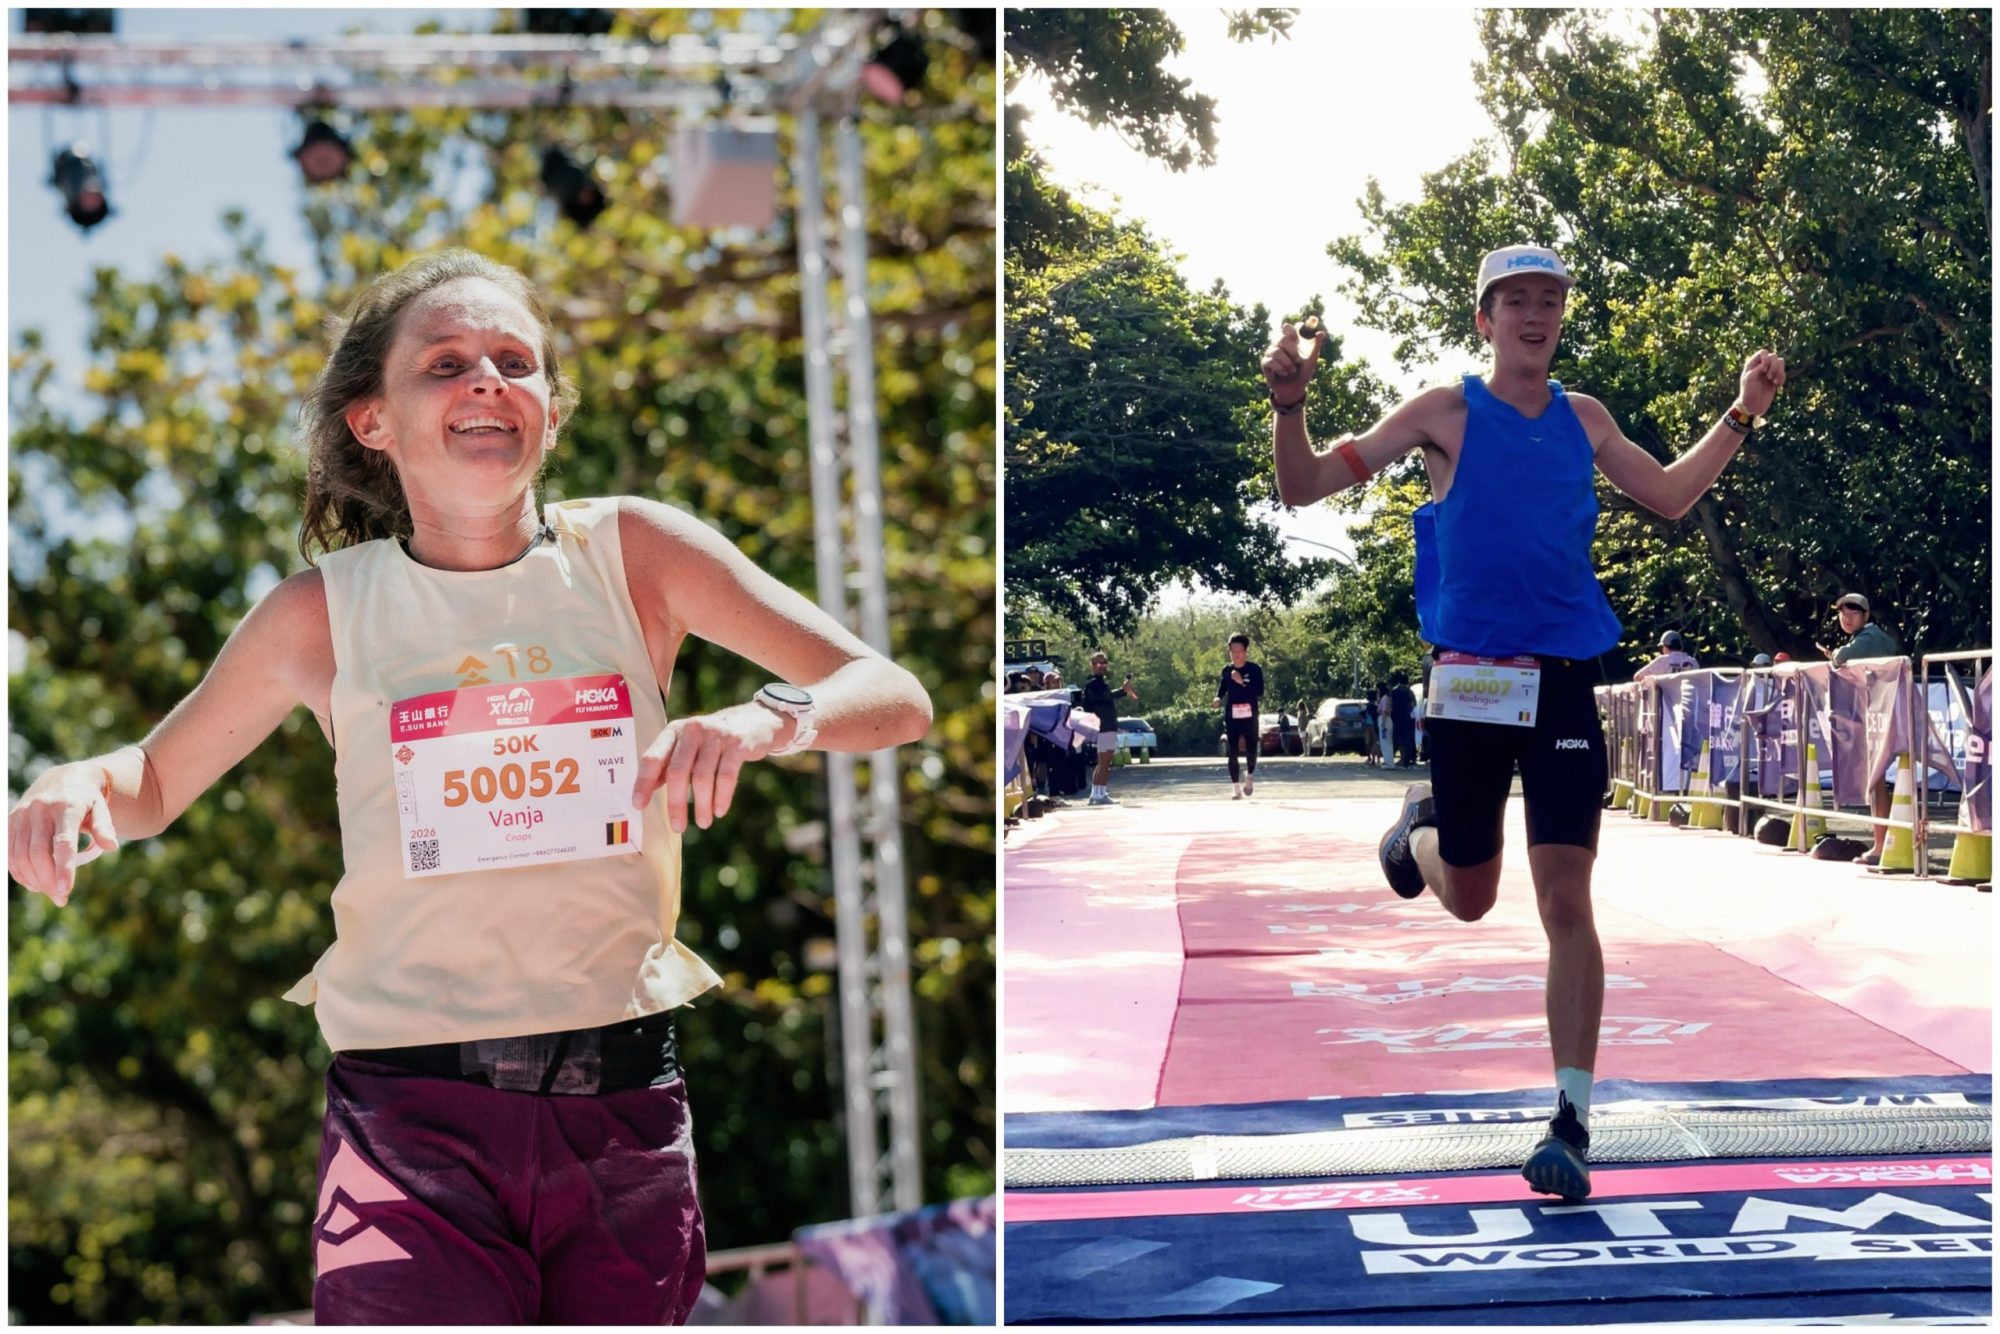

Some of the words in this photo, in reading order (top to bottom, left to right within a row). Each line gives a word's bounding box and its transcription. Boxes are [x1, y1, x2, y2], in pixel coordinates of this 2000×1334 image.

[1506, 255, 1555, 270] HOKA
[1449, 677, 1513, 695] 20007
[575, 687, 618, 705] HOKA
[1459, 694, 1500, 706] Rodrigue
[399, 705, 449, 724] 玉山銀行
[489, 698, 535, 716] Xtrail
[400, 723, 425, 732] E.SUN
[426, 719, 450, 728] BANK
[593, 729, 609, 738] 50K
[493, 734, 540, 756] 50K
[1554, 738, 1590, 750] HOKA
[598, 756, 625, 766] WAVE
[444, 757, 581, 808] 50052
[607, 768, 615, 785] 1
[489, 805, 544, 829] Vanja
[411, 829, 437, 840] 2026
[505, 831, 532, 843] Cnops
[1776, 1167, 1991, 1183] HOKA
[1348, 1191, 1992, 1247] UTM
[1399, 1239, 1797, 1267] WORLD
